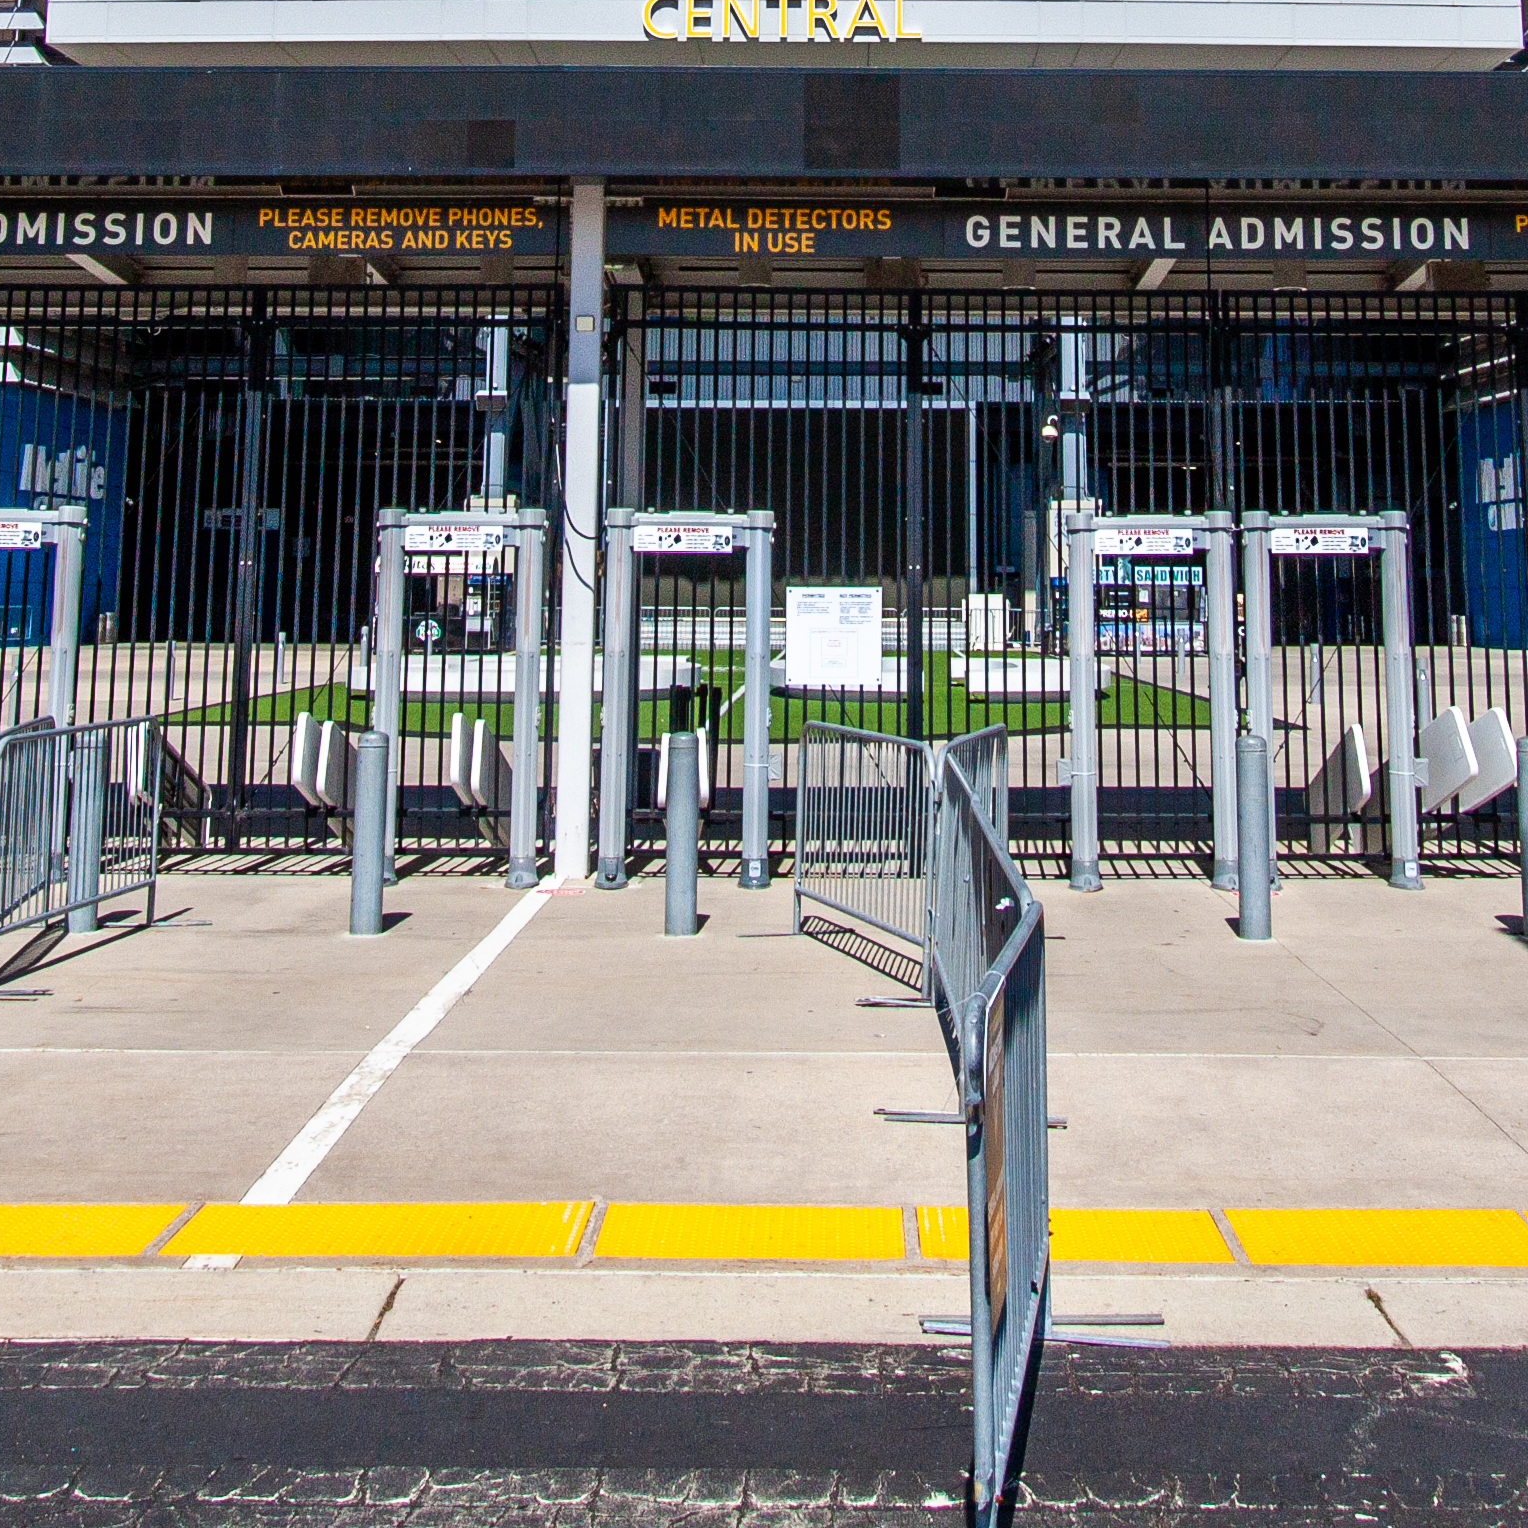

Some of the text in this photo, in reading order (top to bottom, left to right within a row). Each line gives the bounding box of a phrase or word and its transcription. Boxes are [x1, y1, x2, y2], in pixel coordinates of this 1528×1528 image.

[259, 208, 543, 229] PLEASE REMOVE PHONES,
[658, 207, 892, 230] METAL DETECTORS
[288, 230, 513, 249] CAMERAS AND KEYS
[734, 232, 815, 253] IN USE
[965, 214, 1470, 251] GENERAL ADMISSION
